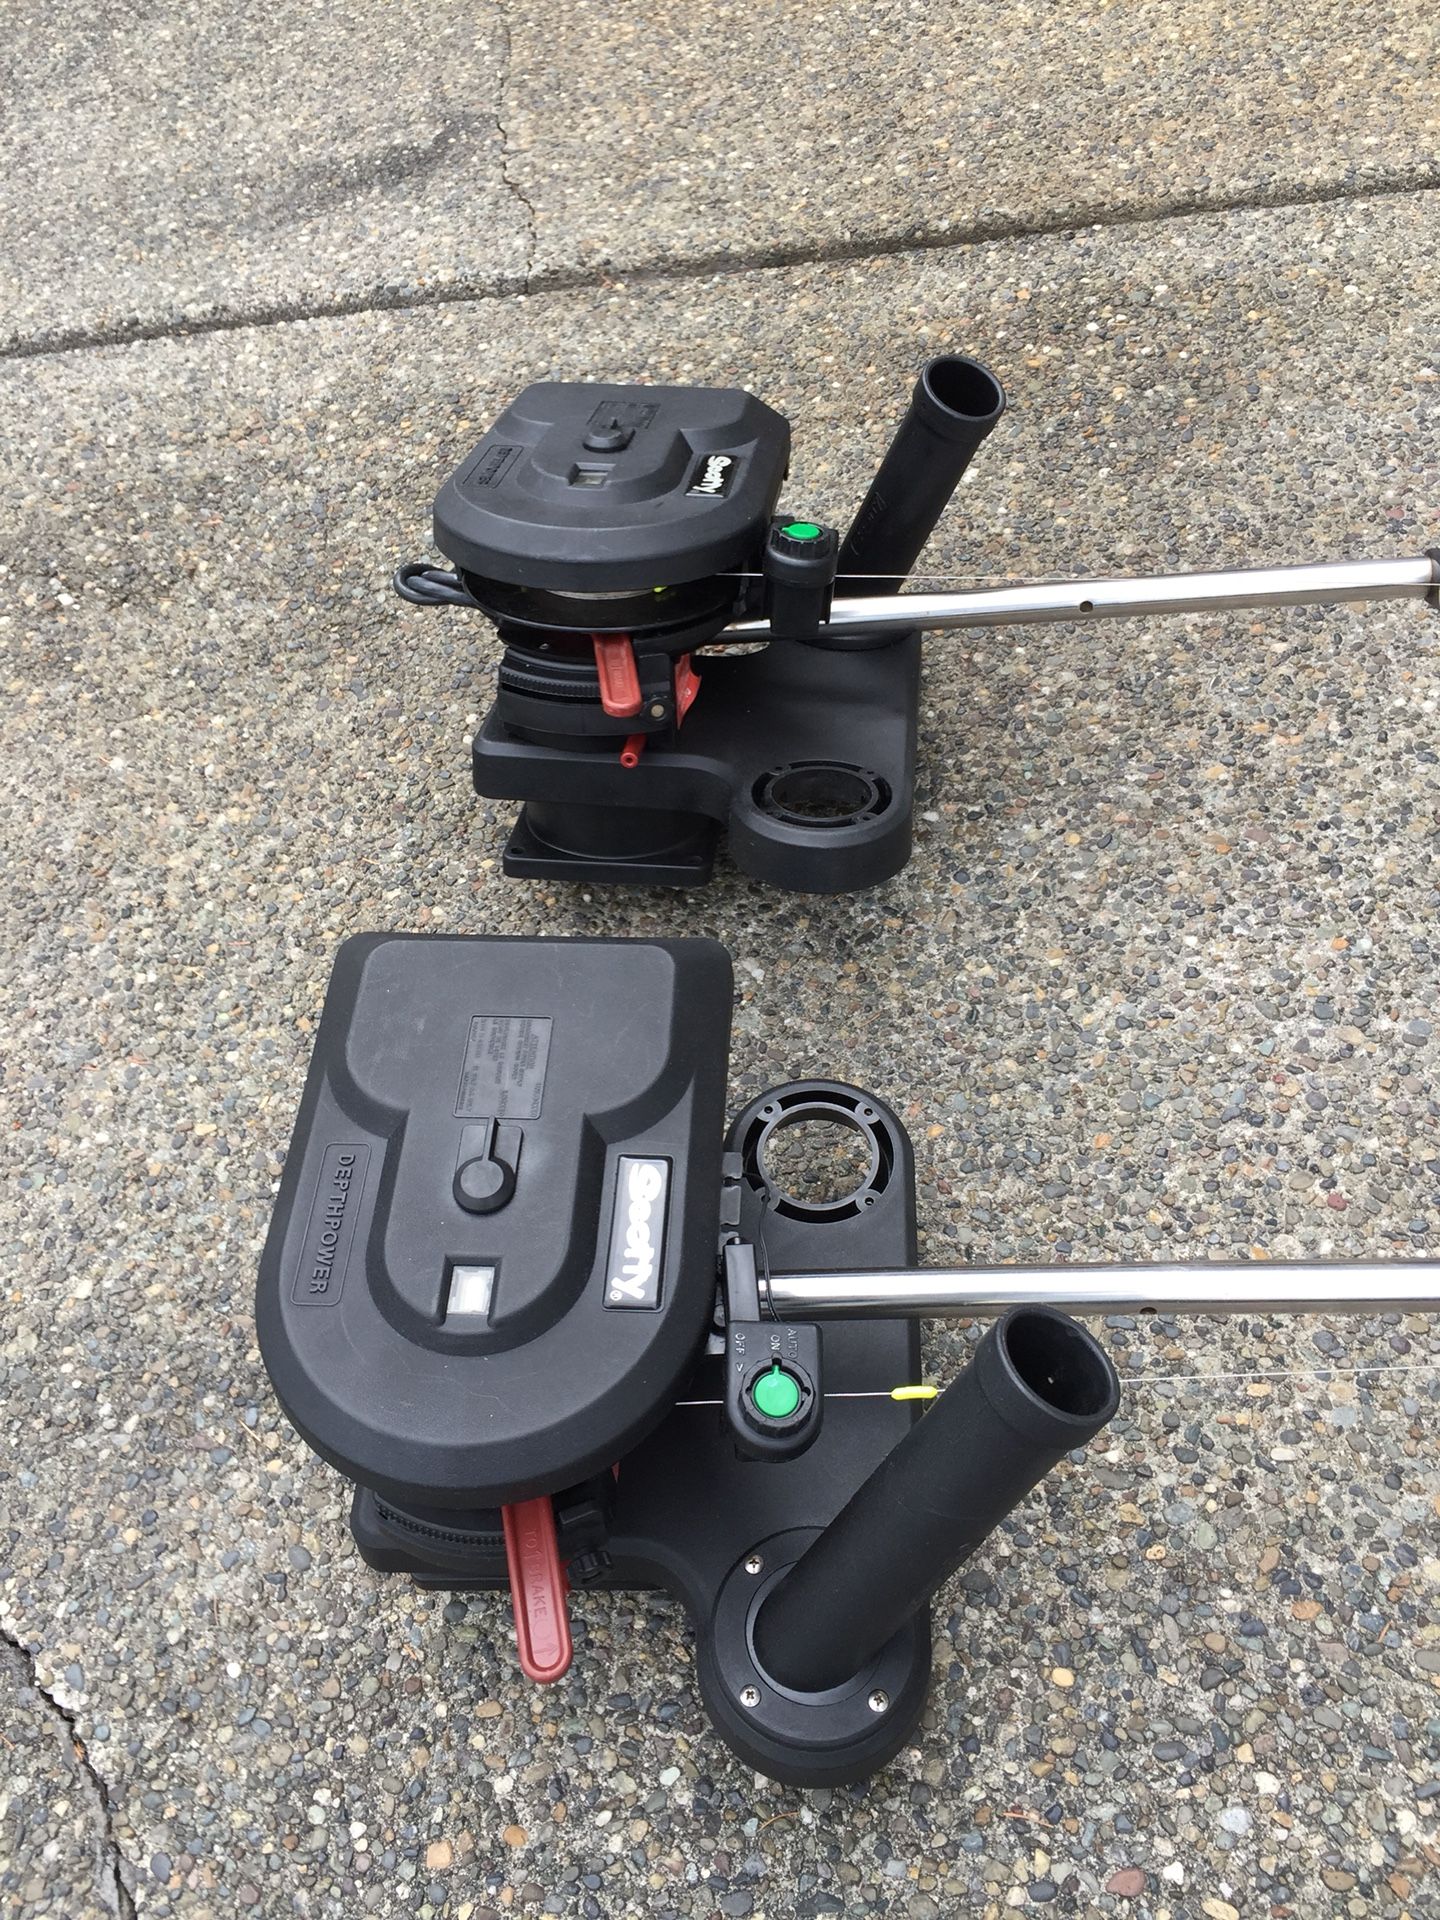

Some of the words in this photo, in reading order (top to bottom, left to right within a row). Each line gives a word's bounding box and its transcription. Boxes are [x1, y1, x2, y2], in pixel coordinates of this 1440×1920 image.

[692, 455, 732, 493] Scotty
[310, 1154, 355, 1294] DEPTHPOWER
[610, 1162, 663, 1300] Scotty
[735, 1332, 746, 1356] OFF
[770, 1334, 781, 1351] ON
[787, 1328, 799, 1360] AUTO
